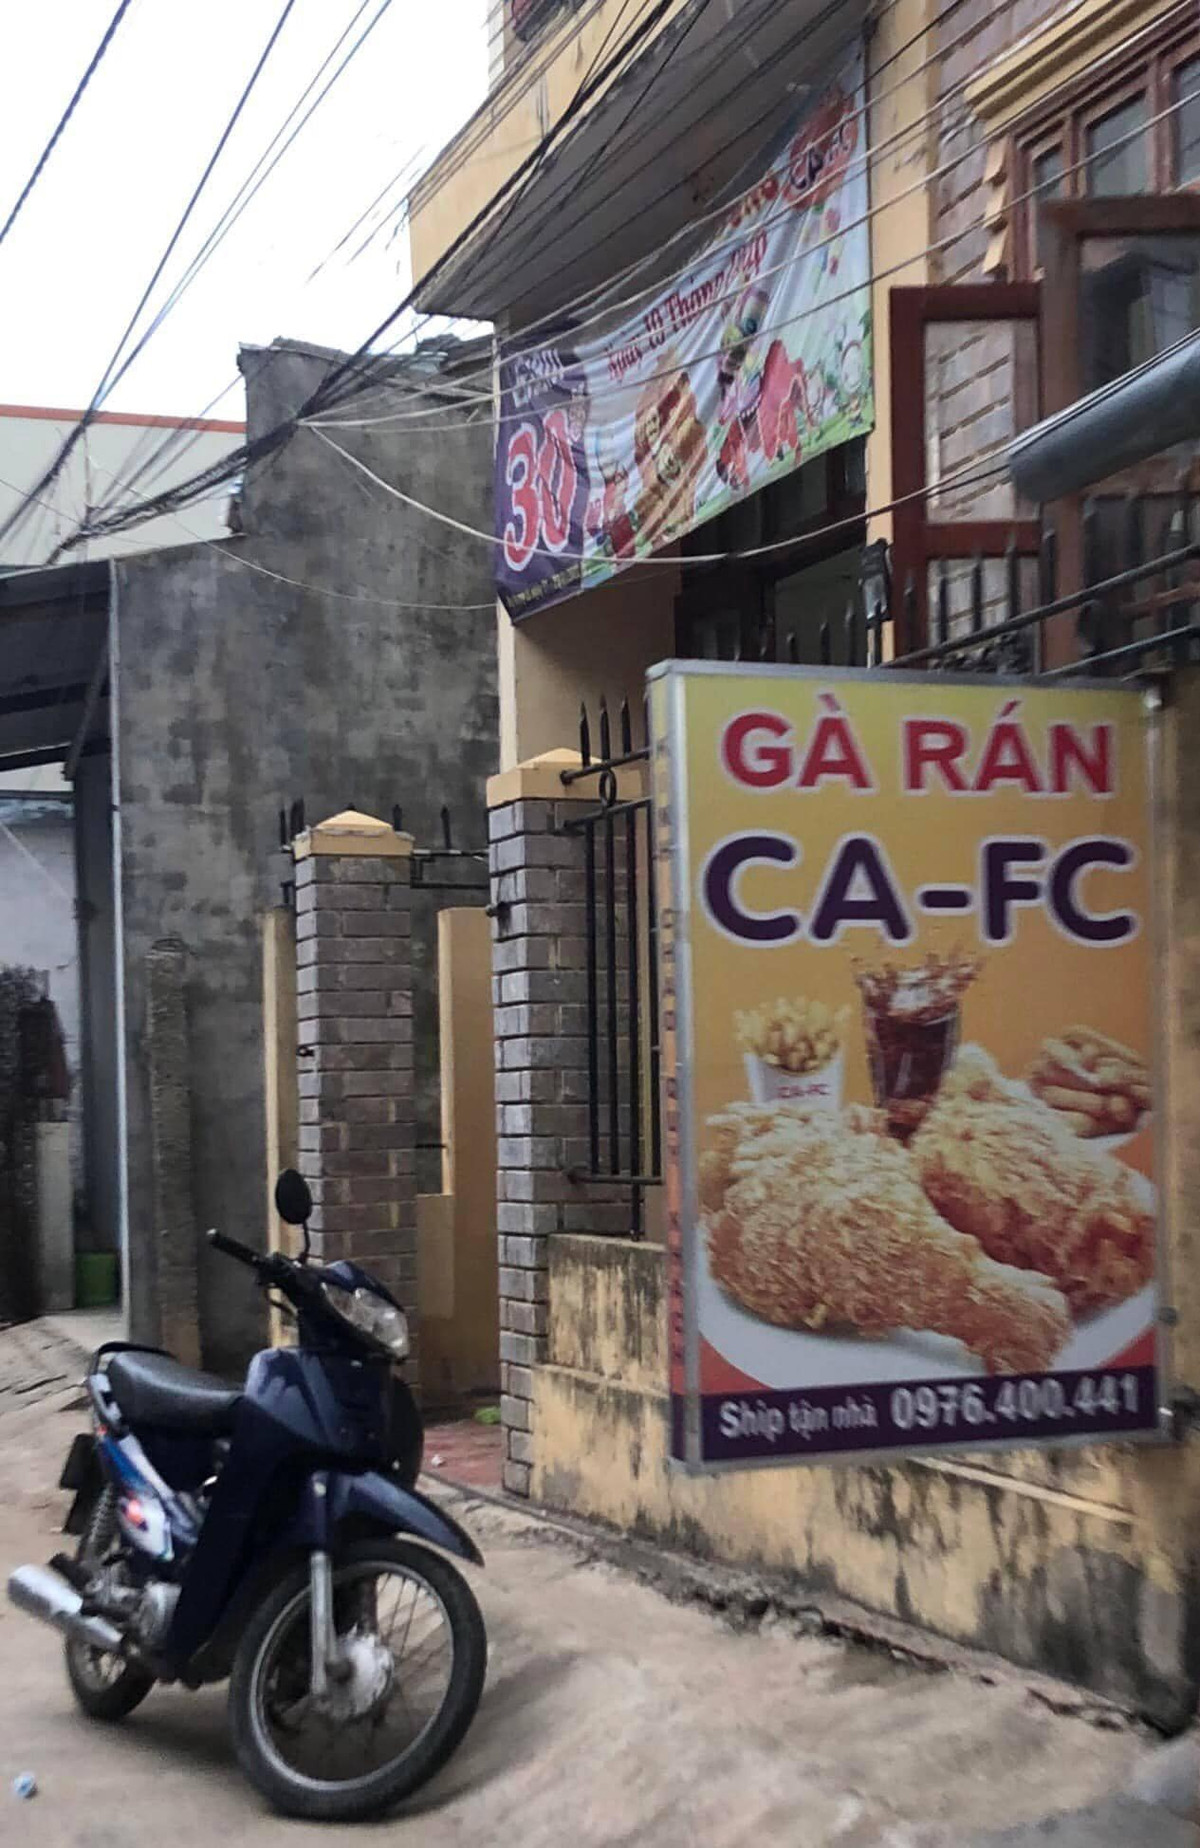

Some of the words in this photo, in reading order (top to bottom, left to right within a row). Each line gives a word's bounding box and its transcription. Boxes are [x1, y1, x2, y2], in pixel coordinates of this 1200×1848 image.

[723, 693, 872, 789] GÀ
[904, 700, 1112, 793] RÁN
[703, 833, 1135, 944] CA-FC
[719, 1399, 784, 1442] Ship
[832, 1395, 878, 1430] nhà
[890, 1373, 1139, 1430] 0976.400.441
